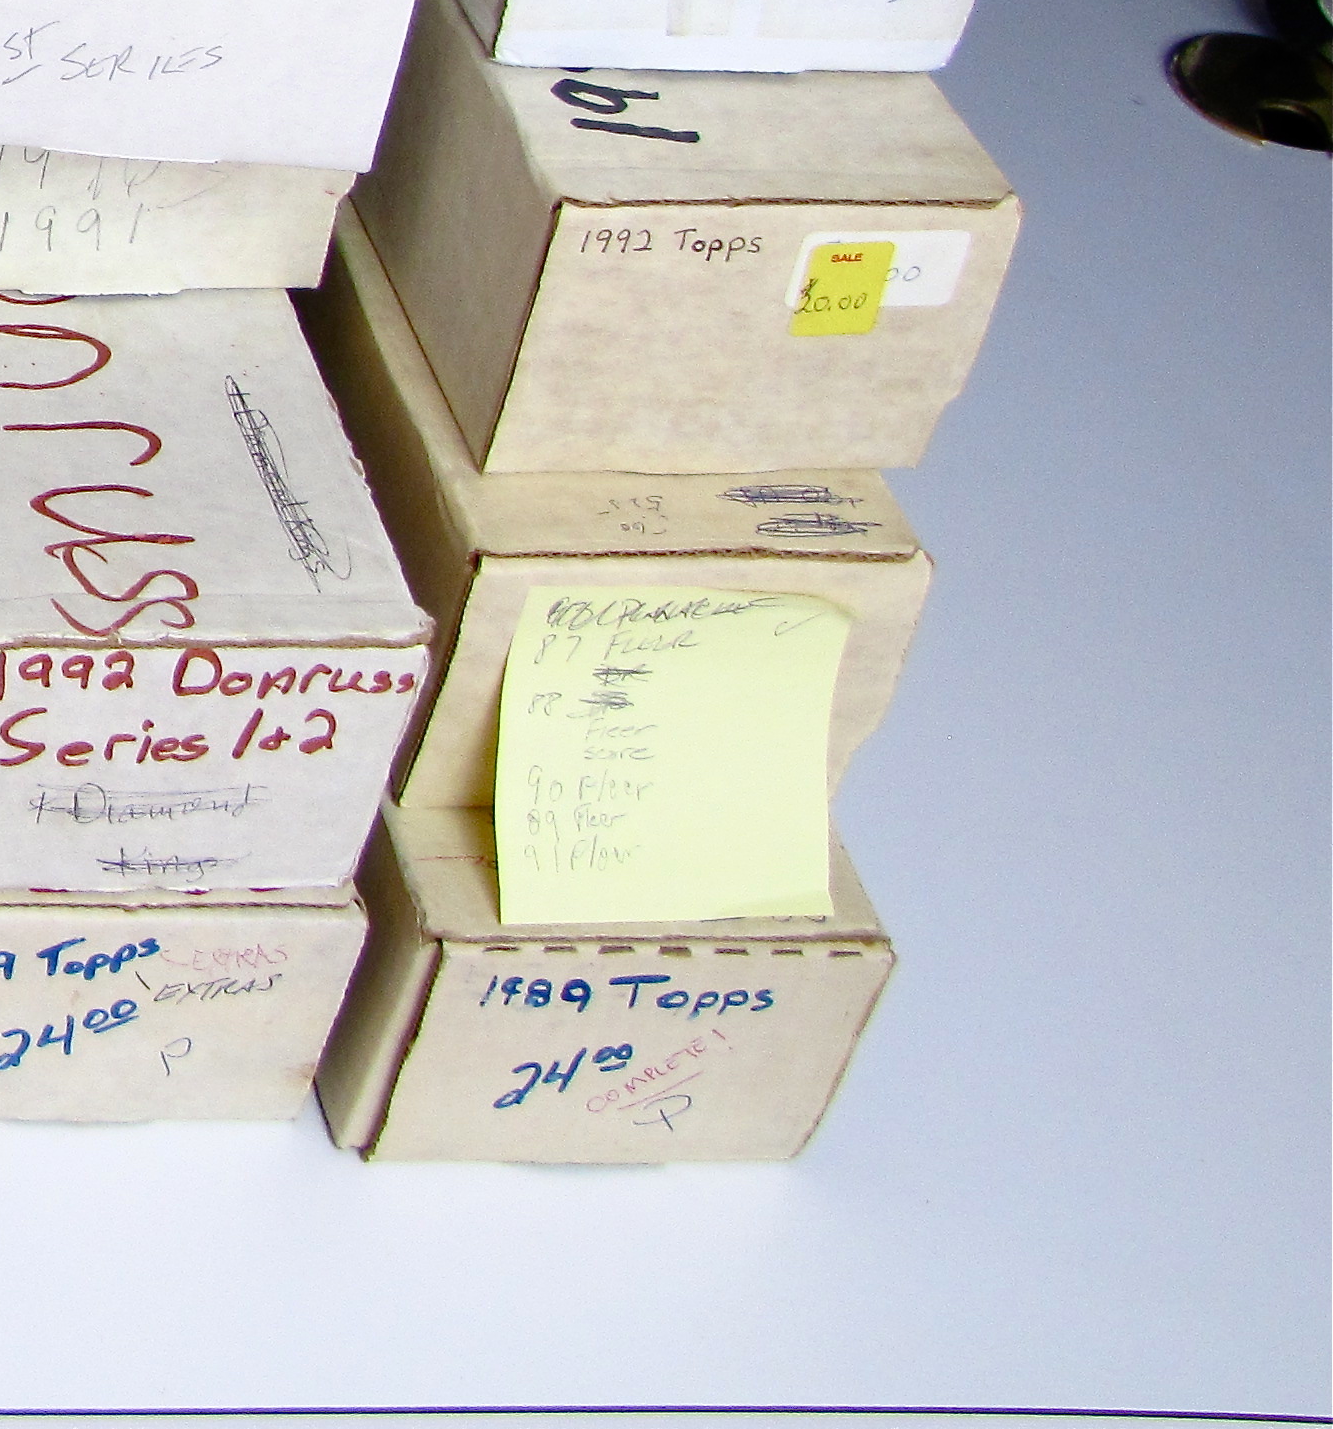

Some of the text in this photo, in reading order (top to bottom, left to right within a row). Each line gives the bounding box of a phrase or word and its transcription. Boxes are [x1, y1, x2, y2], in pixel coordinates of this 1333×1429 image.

[579, 227, 763, 262] 1992 Topps
[831, 253, 863, 263] SALE
[172, 648, 417, 698] Donruss
[36, 937, 161, 981] Topps
[152, 973, 283, 1005] EXTRAS
[479, 973, 775, 1020] 1989 Topps
